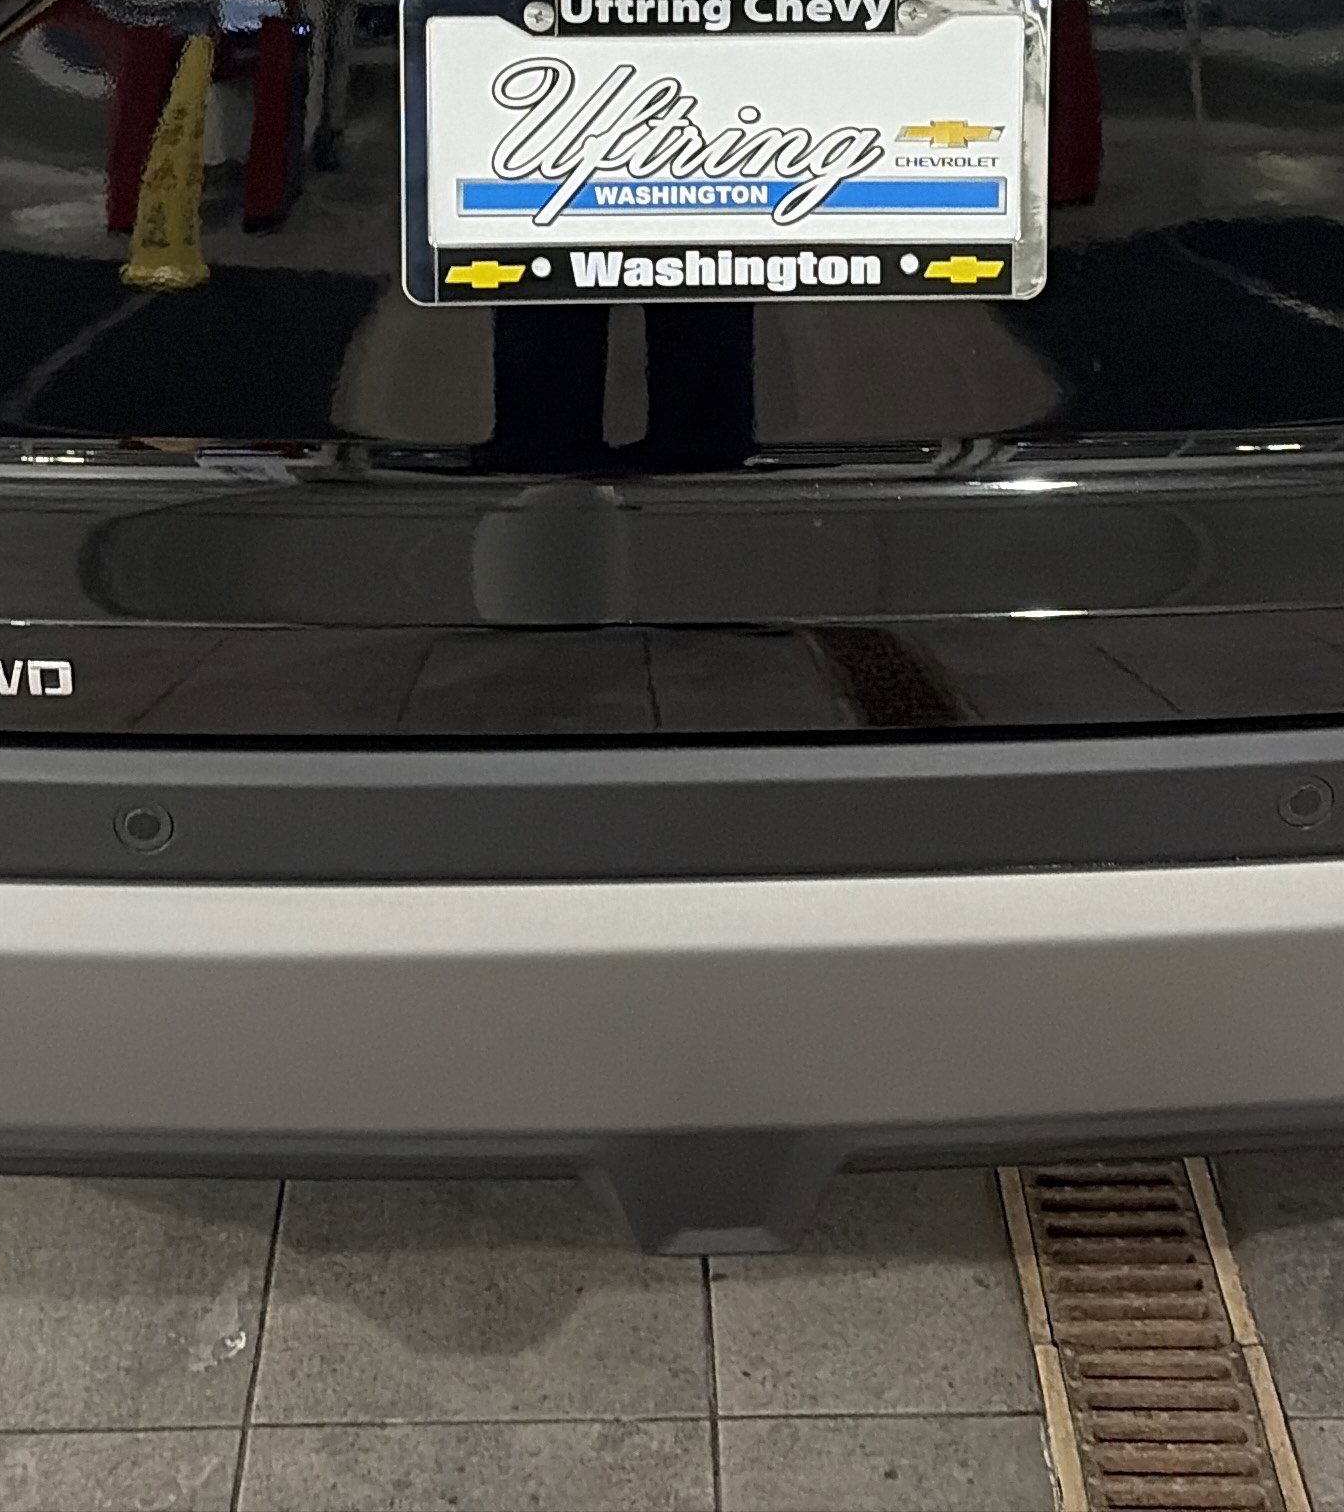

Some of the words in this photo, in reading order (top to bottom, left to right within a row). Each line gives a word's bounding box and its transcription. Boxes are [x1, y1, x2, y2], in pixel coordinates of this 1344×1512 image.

[492, 56, 885, 226] Uftring
[895, 156, 1000, 168] CHEVROLET
[594, 185, 769, 206] WASHINGTON
[569, 250, 882, 292] Washington
